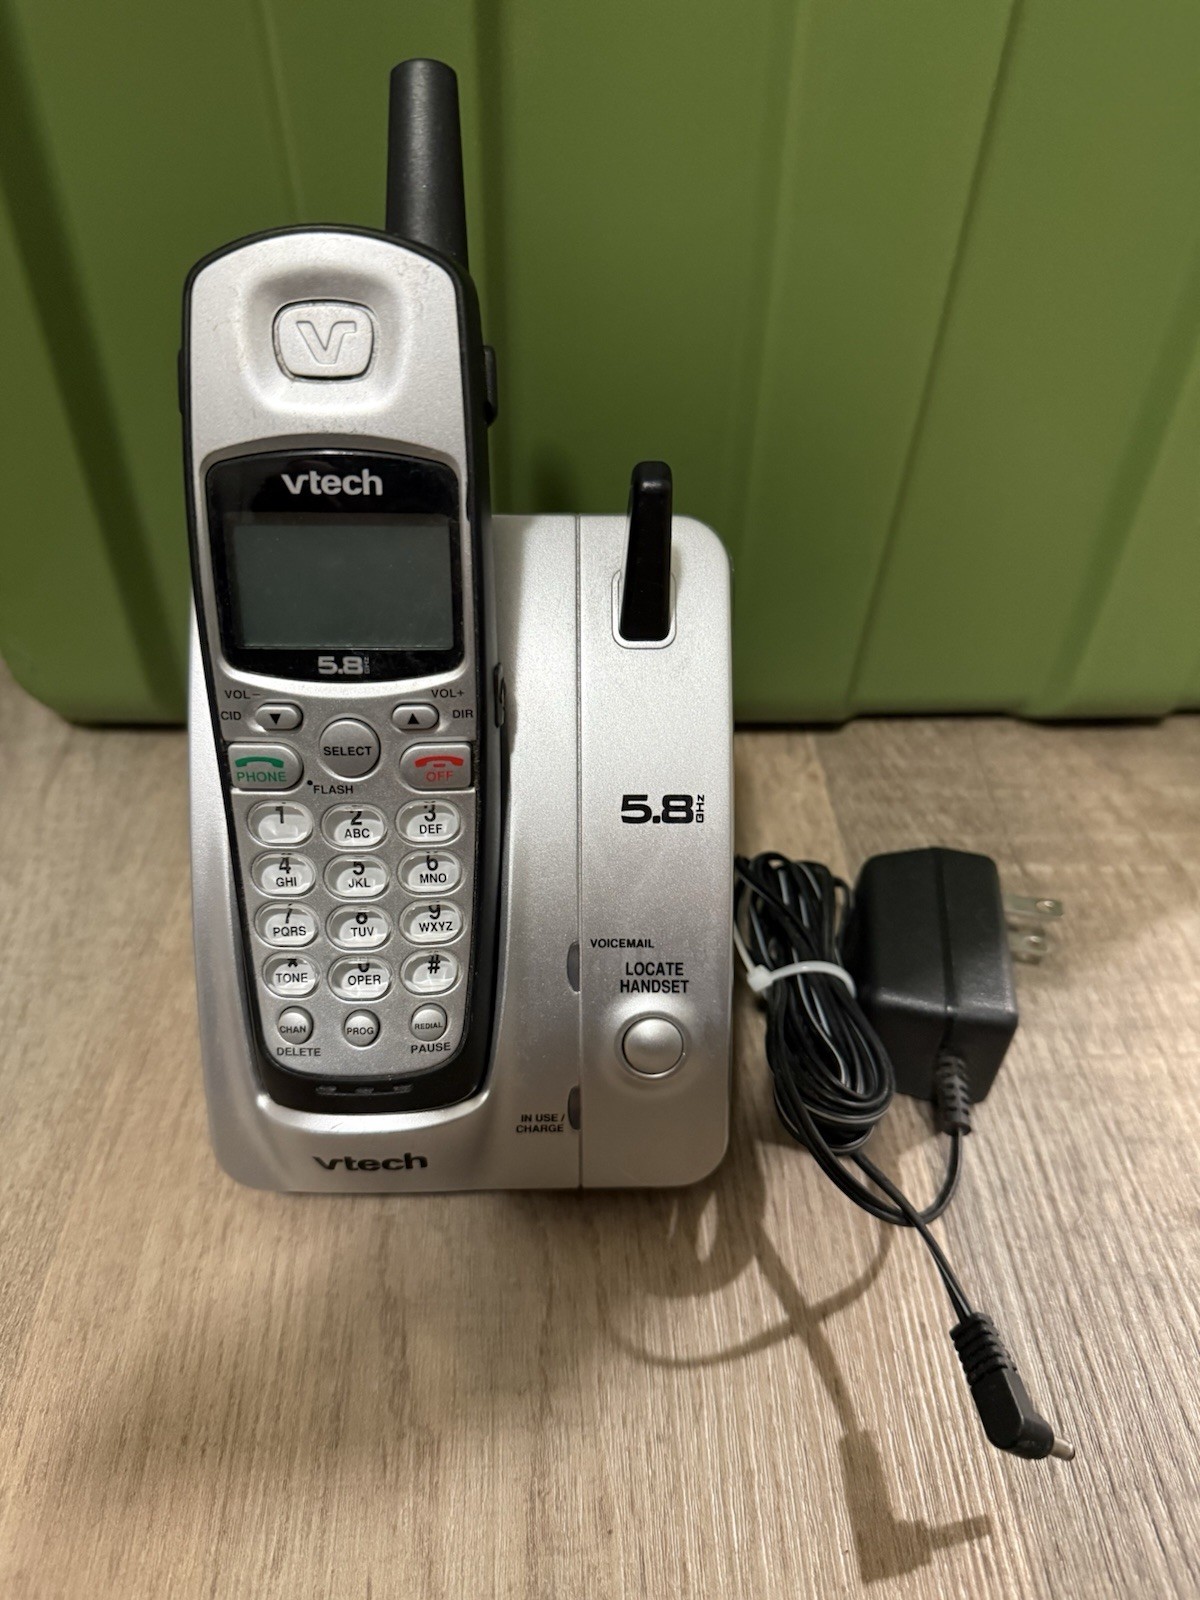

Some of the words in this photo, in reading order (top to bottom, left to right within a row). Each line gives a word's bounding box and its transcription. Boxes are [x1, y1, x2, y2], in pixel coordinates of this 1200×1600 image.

[281, 469, 383, 496] vtech
[318, 655, 364, 675] 5.8
[431, 688, 465, 699] VOL+
[220, 711, 242, 721] CID
[452, 709, 474, 719] DIR
[323, 746, 372, 757] SELECT
[236, 771, 287, 783] PHONE
[426, 771, 453, 783] OFF
[313, 784, 354, 795] FLASH
[275, 805, 285, 825] 1
[423, 804, 436, 823] 3
[620, 793, 695, 825] 5.8
[350, 810, 363, 826] 2
[344, 828, 371, 840] ABC
[419, 823, 443, 835] DEF
[278, 855, 292, 875] 4
[425, 854, 439, 872] 6
[275, 876, 298, 888] GHI
[348, 877, 371, 889] JKL
[419, 872, 447, 885] MNO
[272, 925, 307, 938] PQRS
[350, 926, 375, 938] TUV
[418, 920, 454, 933] WXYZ
[589, 938, 655, 949] VOICEMAIL
[427, 953, 441, 975] #
[625, 961, 684, 977] LOCATE
[275, 972, 309, 984] TONE
[347, 974, 382, 987] OPER
[619, 979, 690, 995] HANDSET
[279, 1024, 307, 1035] CHAN
[346, 1026, 375, 1037] PROG
[414, 1021, 444, 1031] REDIAL
[276, 1046, 322, 1058] DELETE
[410, 1042, 452, 1055] PAUSE
[520, 1113, 533, 1123] IN
[535, 1112, 559, 1123] USE
[515, 1123, 564, 1134] CHARGE
[312, 1152, 429, 1172] vtech
